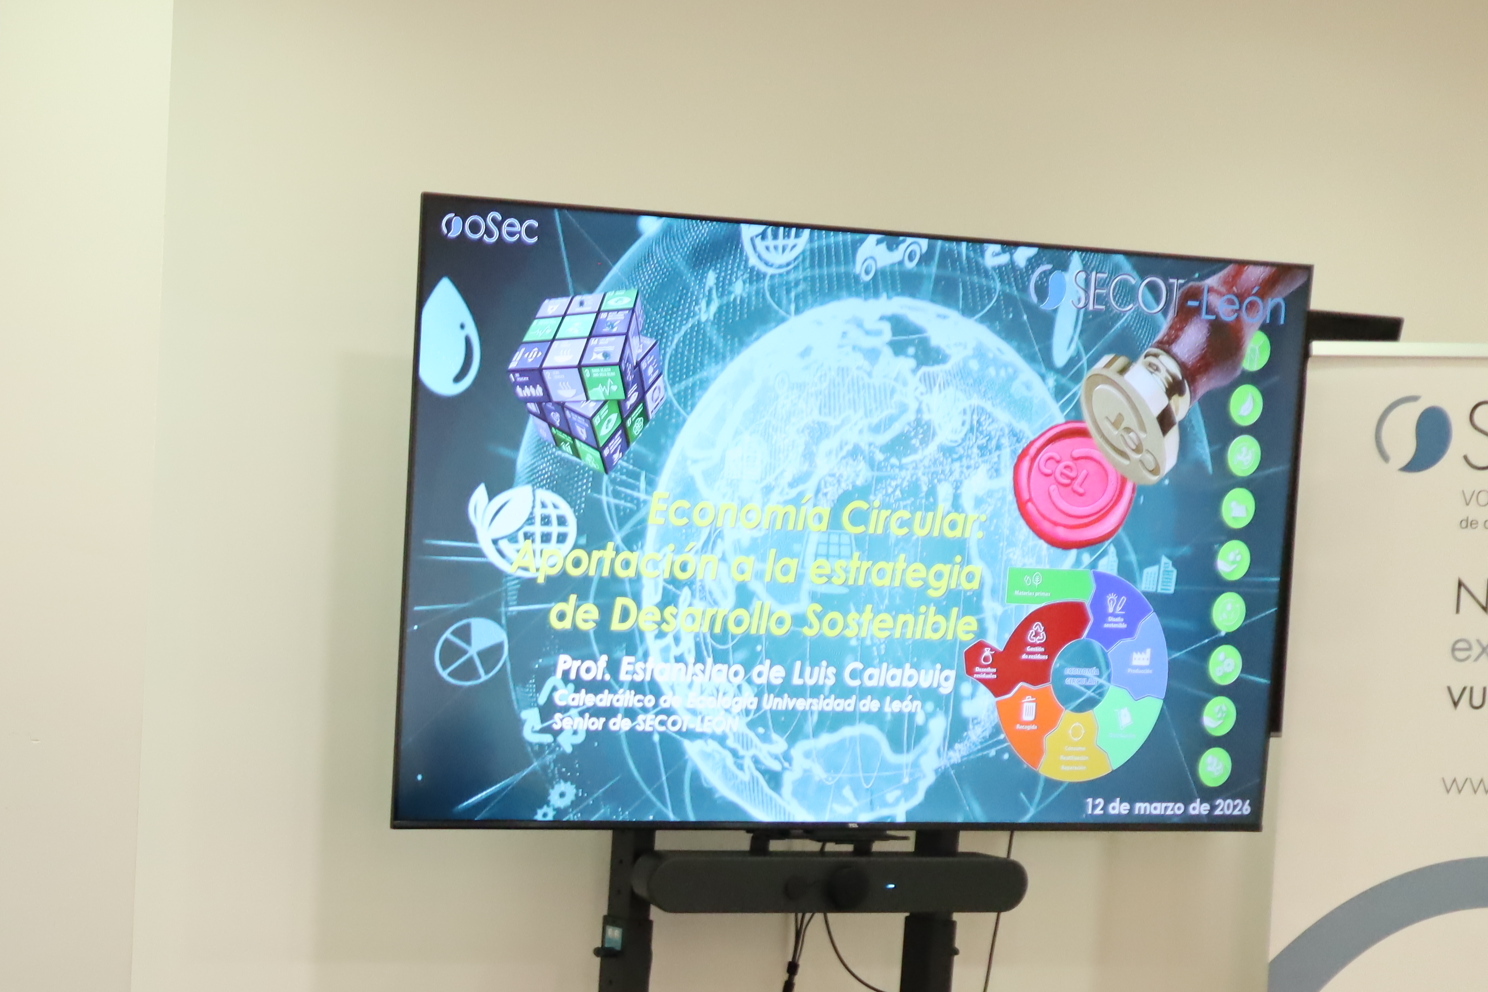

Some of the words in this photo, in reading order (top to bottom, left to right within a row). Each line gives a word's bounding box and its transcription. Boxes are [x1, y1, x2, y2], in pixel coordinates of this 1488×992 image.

[648, 491, 832, 531] Economía
[842, 498, 987, 539] Circular:
[1459, 516, 1479, 530] de
[512, 539, 720, 584] Aportación
[731, 554, 755, 582] a
[765, 548, 799, 583] la
[809, 551, 983, 598] estrategia
[548, 594, 600, 631] de
[610, 596, 792, 637] Desarrollo
[802, 603, 979, 642] Sostenible
[555, 654, 611, 682] Prof.
[619, 655, 746, 684] Estanislao
[752, 658, 786, 685] de
[791, 660, 837, 686] Luis
[844, 661, 957, 695] Calabuig
[553, 688, 656, 708] Catedrático
[660, 690, 682, 708] de
[762, 693, 858, 713] Universidad
[859, 694, 881, 713] de
[884, 694, 923, 713] León
[1447, 686, 1488, 710] VU
[552, 713, 606, 731] Senior
[608, 713, 633, 731] de
[1086, 798, 1104, 815] 12
[1109, 797, 1130, 815] de
[1135, 801, 1185, 815] marzo
[1189, 798, 1210, 815] de
[1214, 799, 1251, 815] 2026
